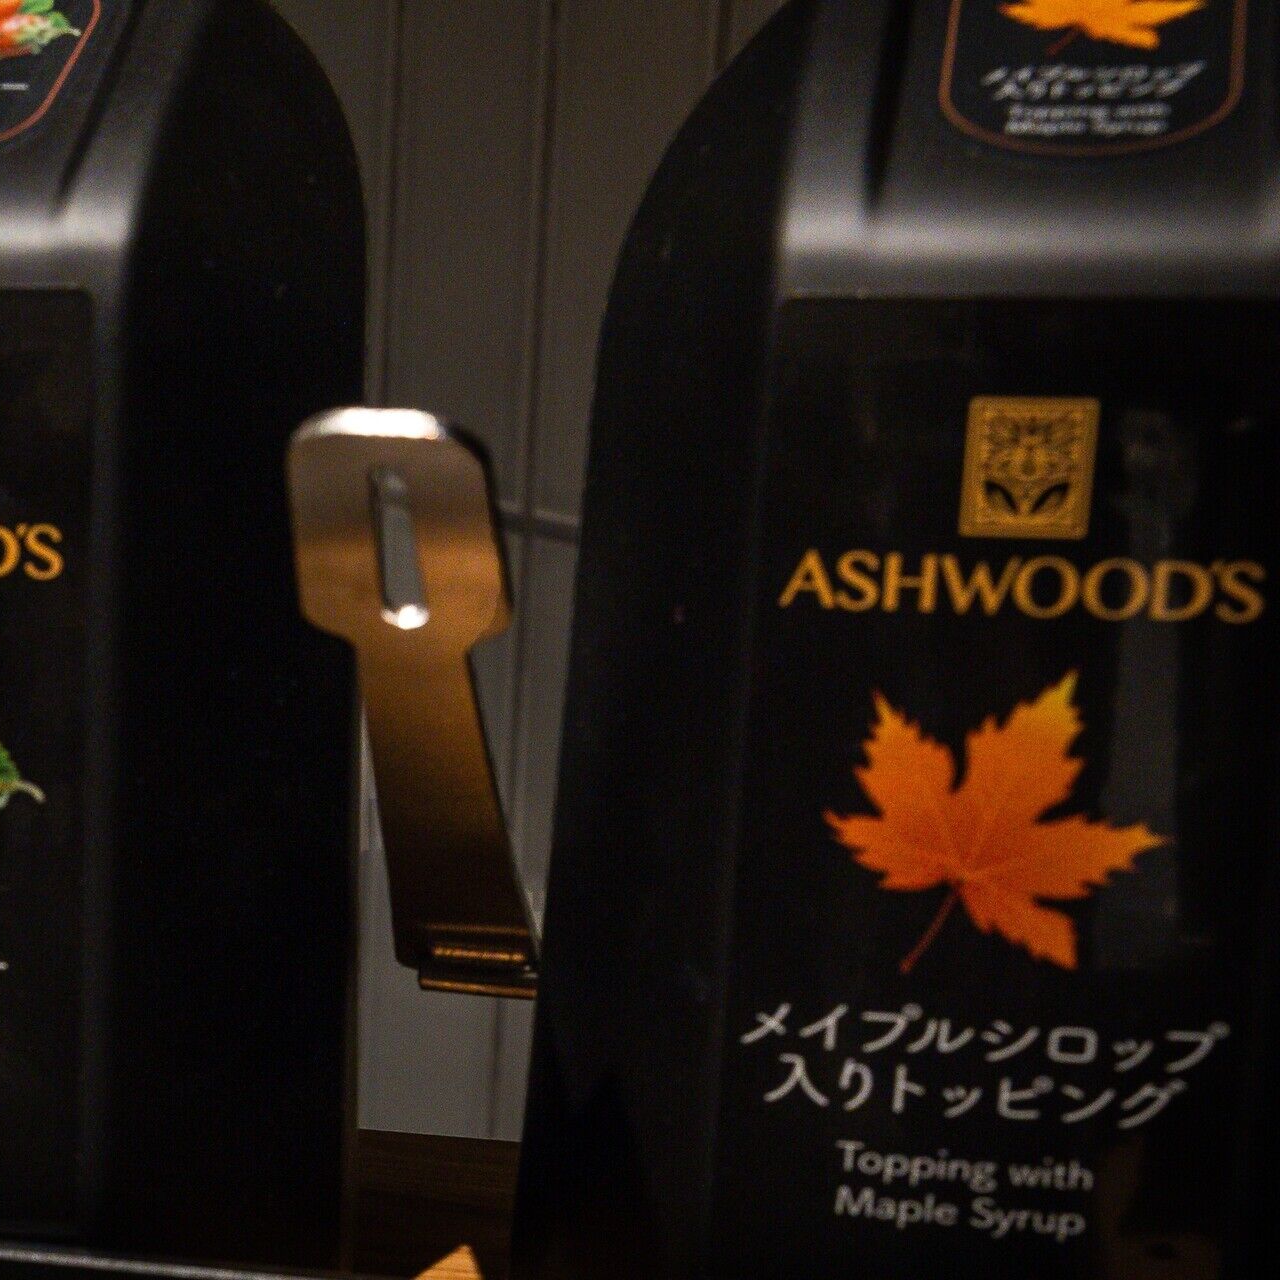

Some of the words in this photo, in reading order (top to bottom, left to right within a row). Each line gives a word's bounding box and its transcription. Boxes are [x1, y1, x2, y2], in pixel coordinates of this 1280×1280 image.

[778, 548, 1265, 624] ASHWOOD'S
[741, 1003, 1231, 1073] メイプルシロップ
[763, 1053, 1187, 1129] 入りトッピング
[836, 1140, 995, 1191] Topping
[1009, 1156, 1093, 1190] with
[834, 1184, 959, 1227] Maple
[970, 1196, 1086, 1243] Syrup
